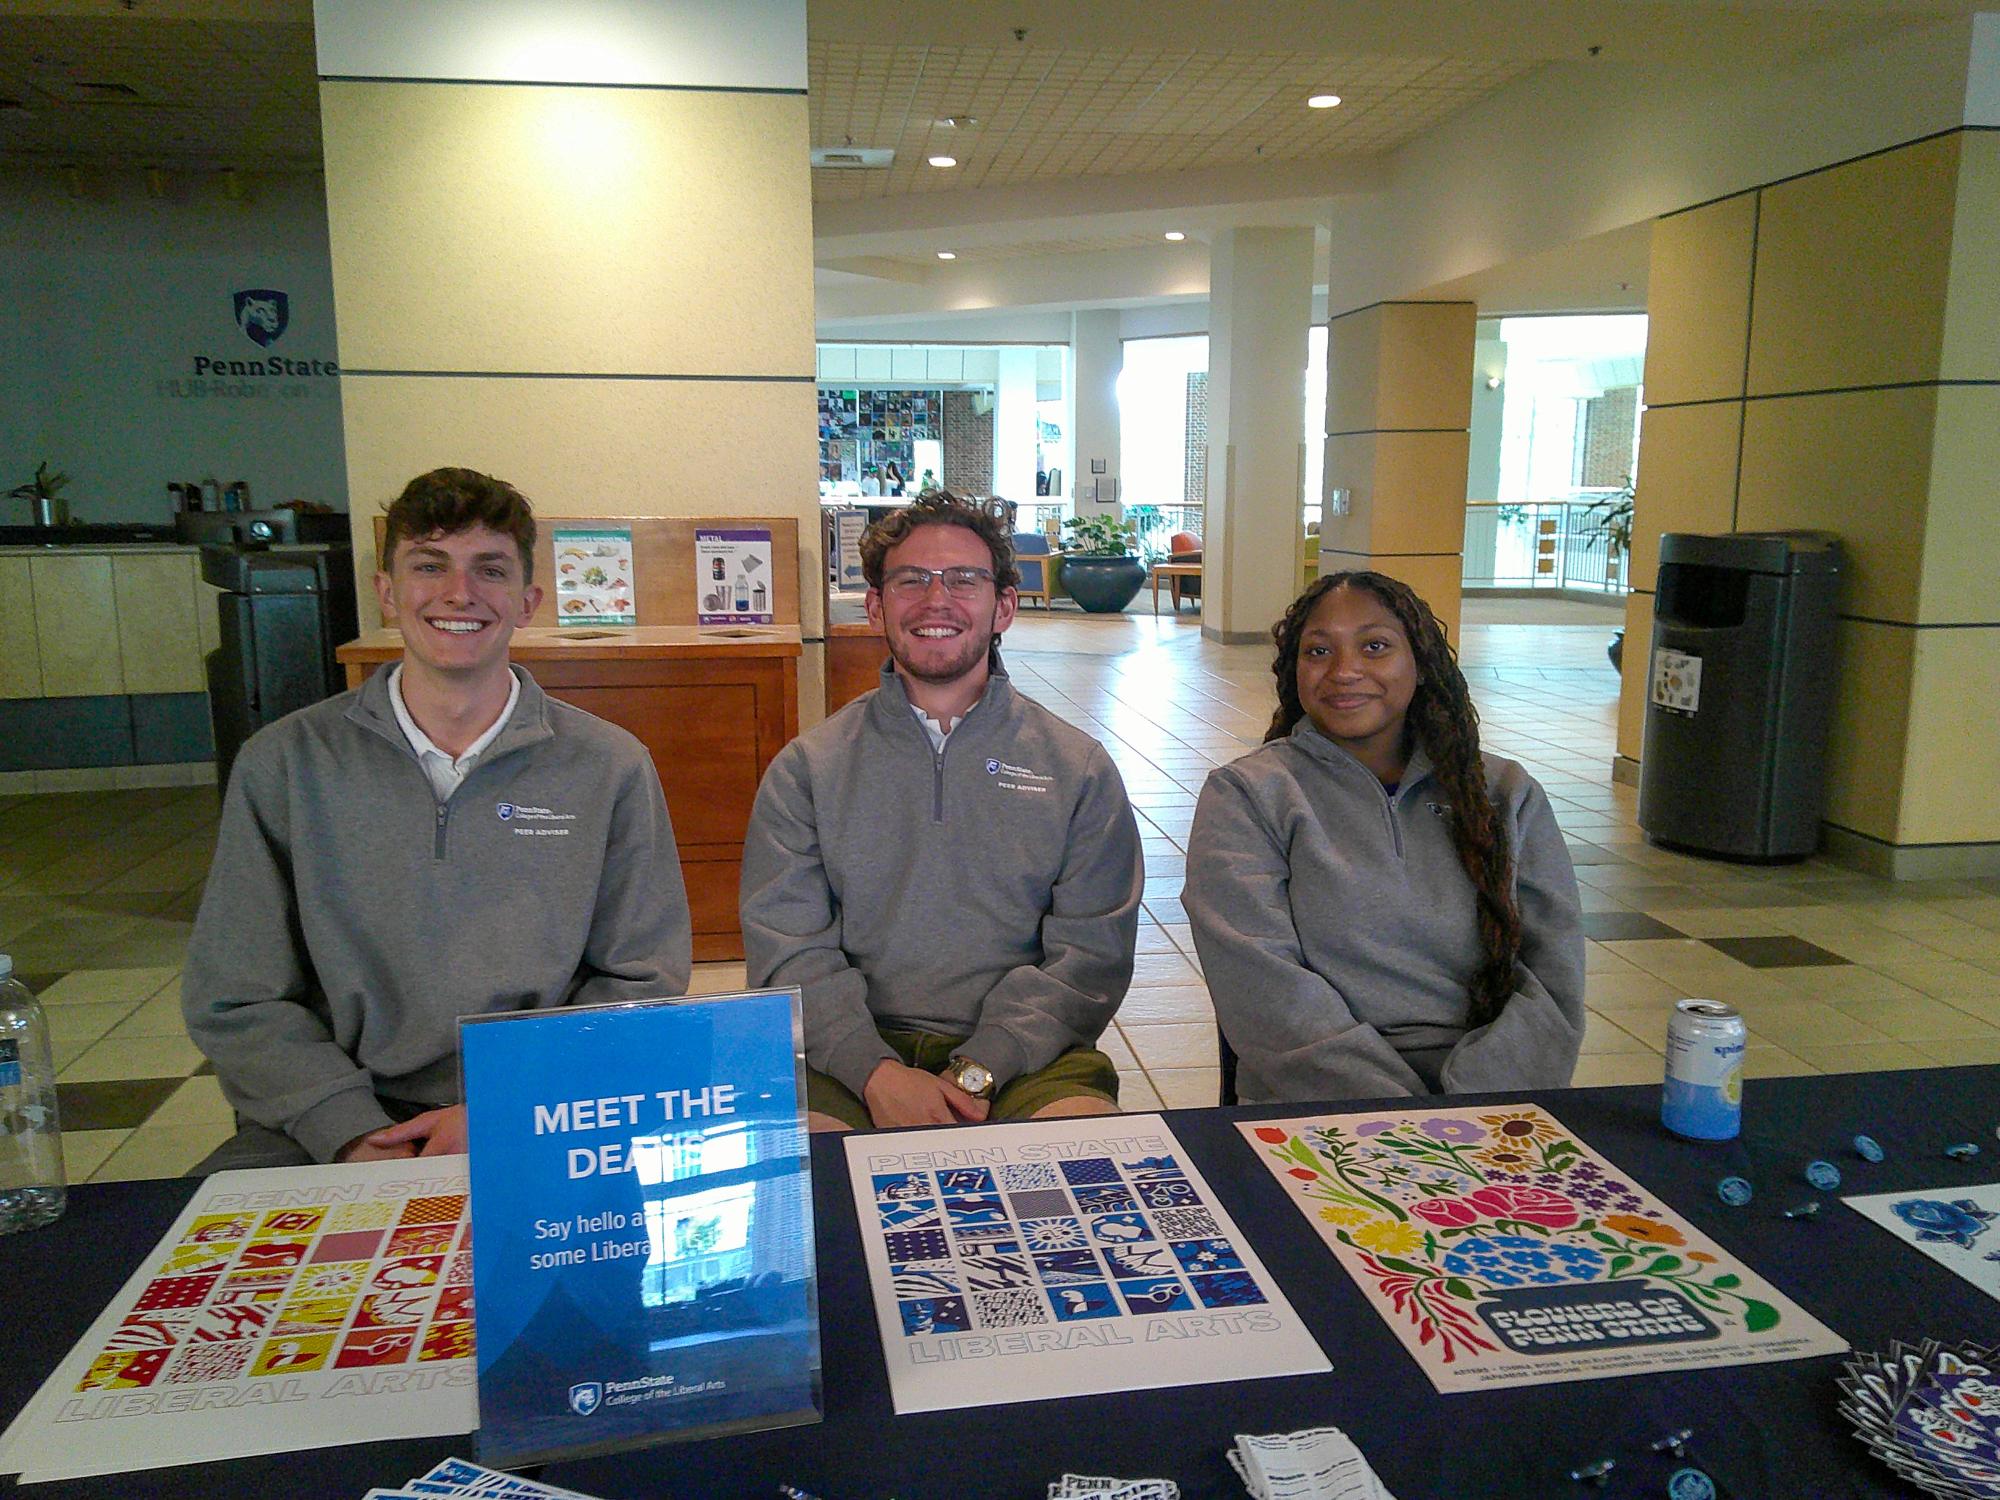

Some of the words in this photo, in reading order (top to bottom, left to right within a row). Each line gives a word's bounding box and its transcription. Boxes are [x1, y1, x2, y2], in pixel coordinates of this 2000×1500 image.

[194, 356, 339, 376] PennState
[534, 1094, 645, 1135] MEET
[656, 1084, 735, 1120] THE
[568, 1134, 706, 1180] DEAS
[868, 1146, 1006, 1172] PENN
[1016, 1136, 1168, 1163] STATE
[202, 1183, 363, 1212] PENN
[376, 1176, 470, 1200] STA
[534, 1219, 572, 1241] Say
[577, 1211, 626, 1233] hello
[530, 1248, 586, 1270] some
[591, 1240, 652, 1262] Libera
[1490, 1300, 1643, 1329] FLOWERS
[1640, 1297, 1683, 1316] OF
[907, 1325, 1133, 1365] LIBERAL
[1145, 1311, 1282, 1342] ARTS
[1507, 1322, 1605, 1347] PENN
[1601, 1314, 1706, 1338] STATE
[55, 1379, 306, 1423] LIBERAL
[320, 1367, 476, 1399] ARTS
[605, 1375, 675, 1394] PennState
[605, 1393, 641, 1406] College
[642, 1390, 655, 1400] of
[655, 1388, 672, 1398] the
[673, 1382, 705, 1396] Liberal
[706, 1381, 727, 1391] Arts
